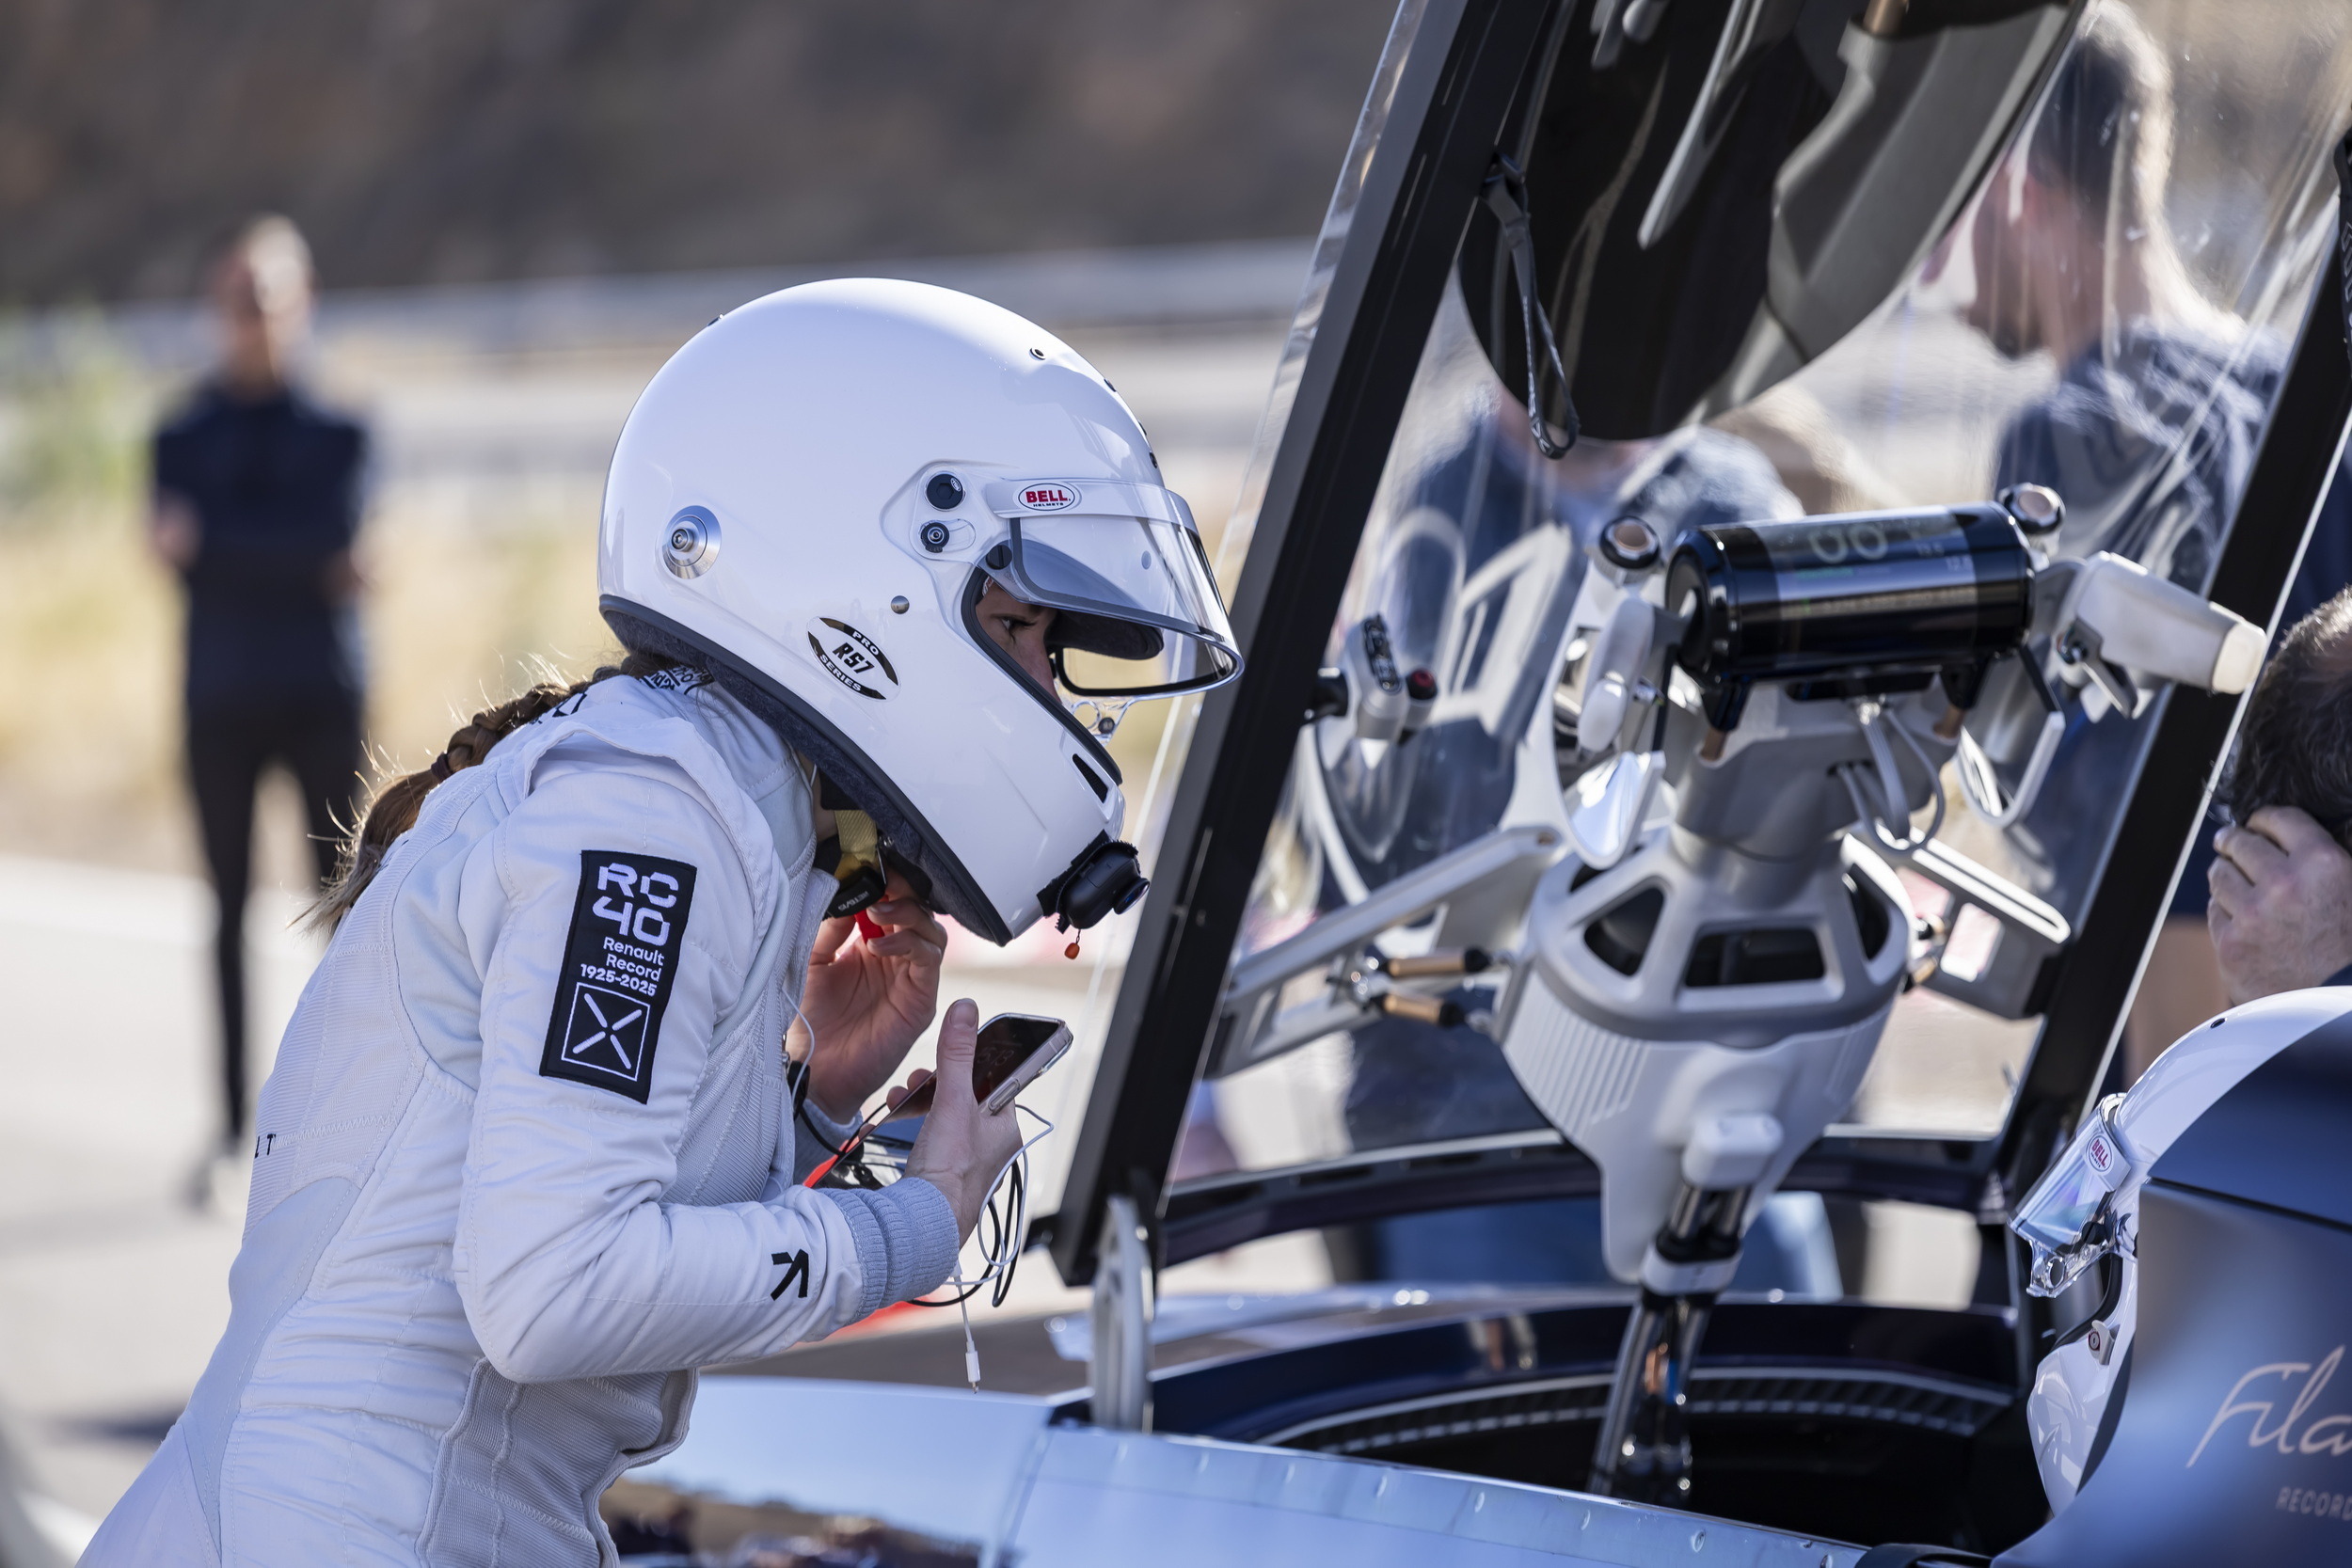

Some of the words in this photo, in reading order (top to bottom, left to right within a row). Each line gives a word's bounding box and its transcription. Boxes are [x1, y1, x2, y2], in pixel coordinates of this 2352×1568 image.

[1025, 489, 1068, 503] BELL
[832, 641, 875, 674] RS7
[851, 630, 880, 656] PRO
[819, 654, 862, 691] SERIES
[597, 863, 678, 909] RC
[592, 895, 671, 946] 40
[603, 937, 664, 966] Renault
[606, 953, 661, 981] Record
[580, 963, 658, 997] 1925-2025
[2091, 1138, 2108, 1167] BELL
